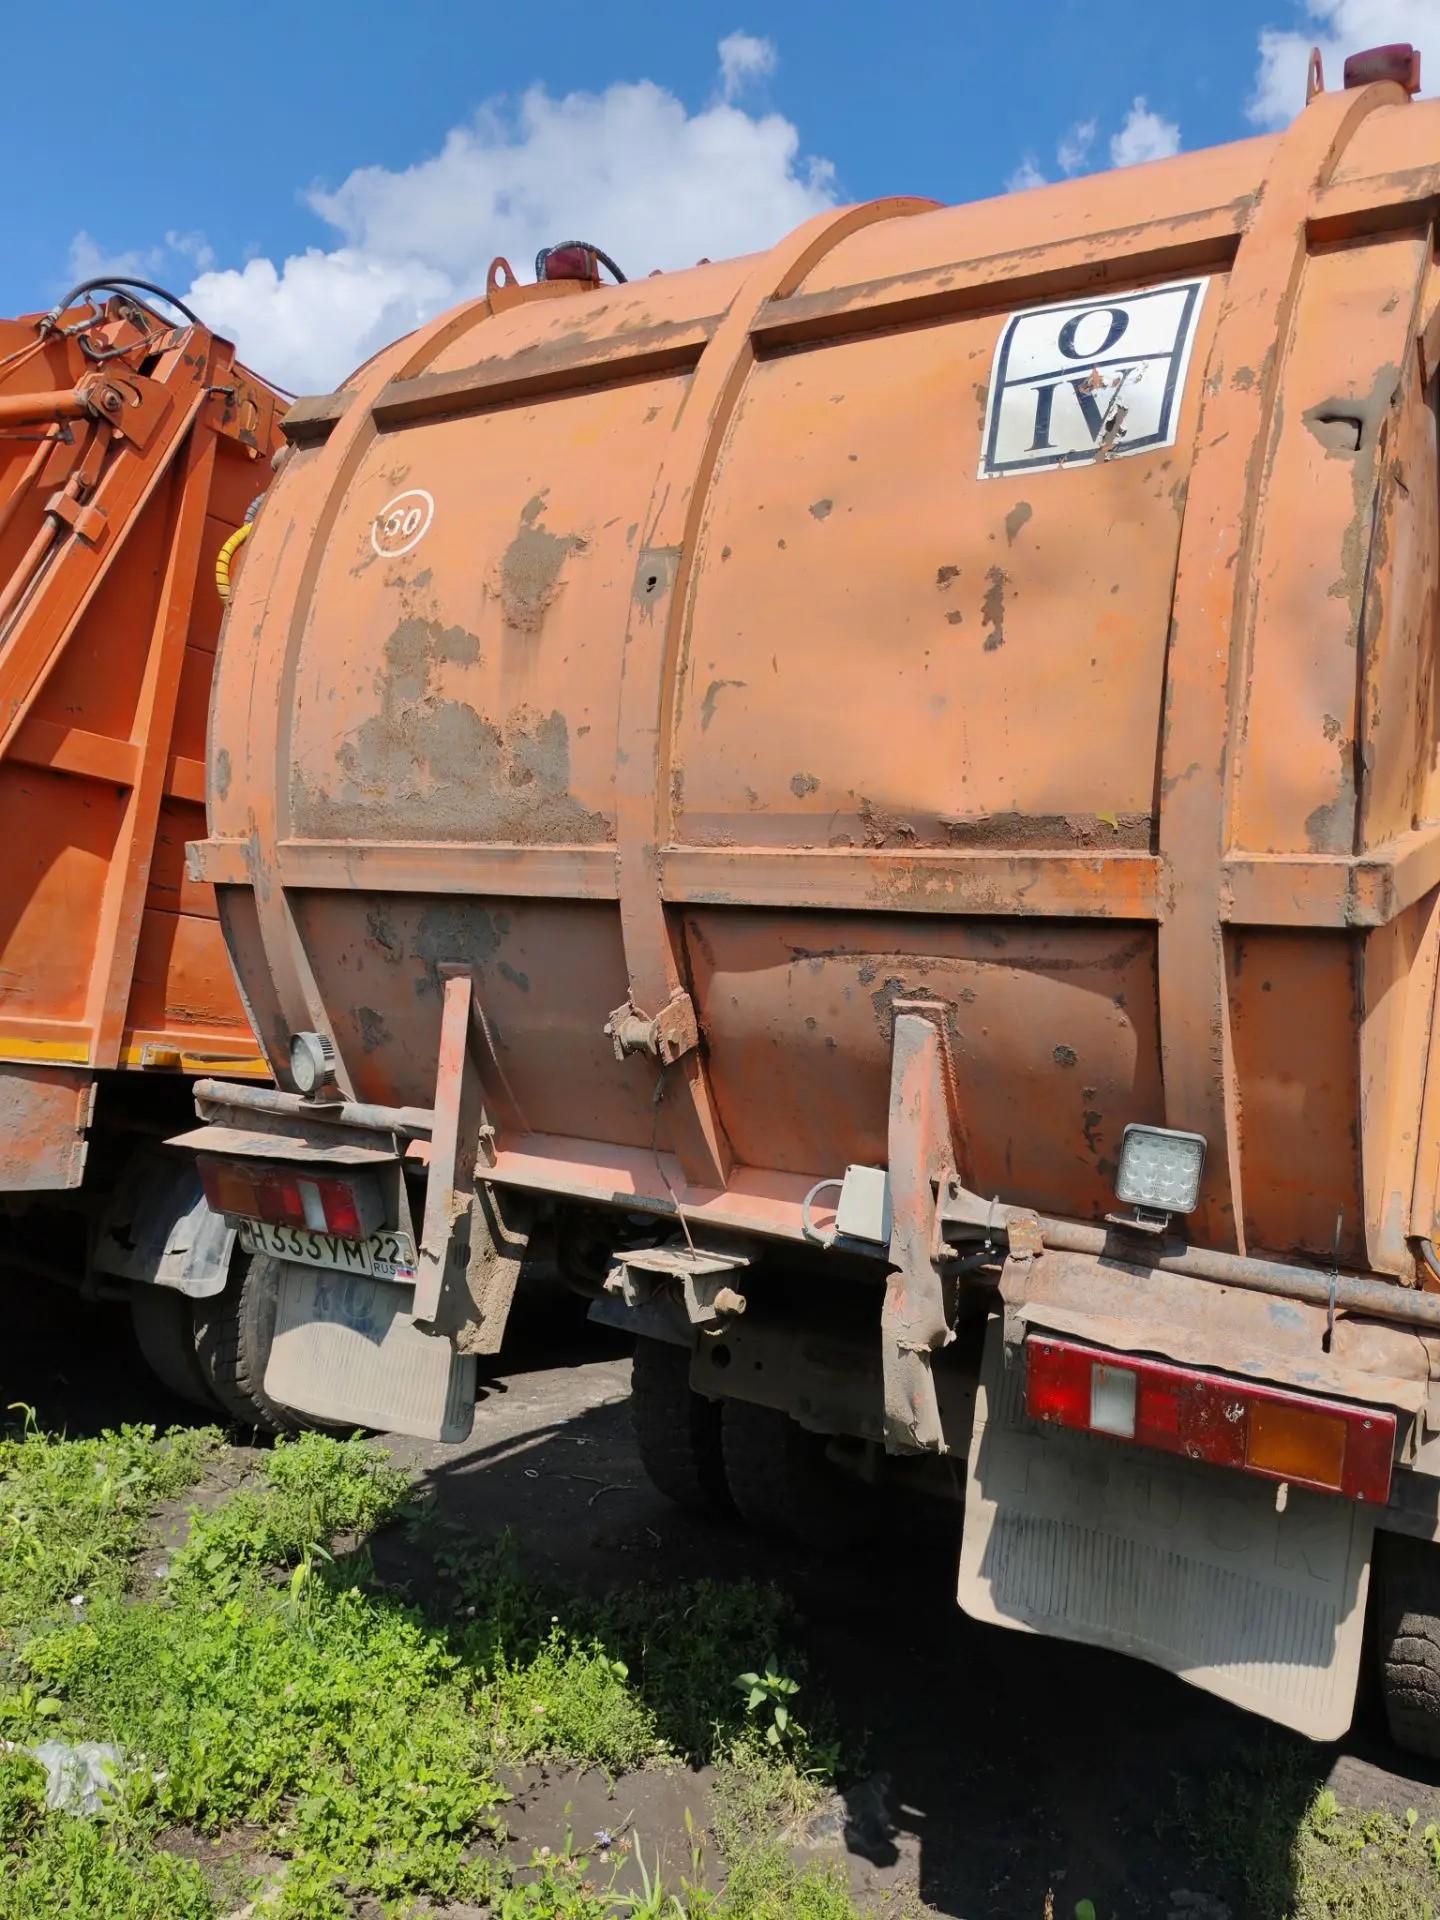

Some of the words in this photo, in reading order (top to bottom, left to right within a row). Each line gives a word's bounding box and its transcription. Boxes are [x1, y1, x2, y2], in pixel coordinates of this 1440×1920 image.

[1058, 308, 1130, 360] O
[1024, 367, 1138, 452] IV
[369, 1235, 402, 1264] 22
[373, 1262, 397, 1275] RUS
